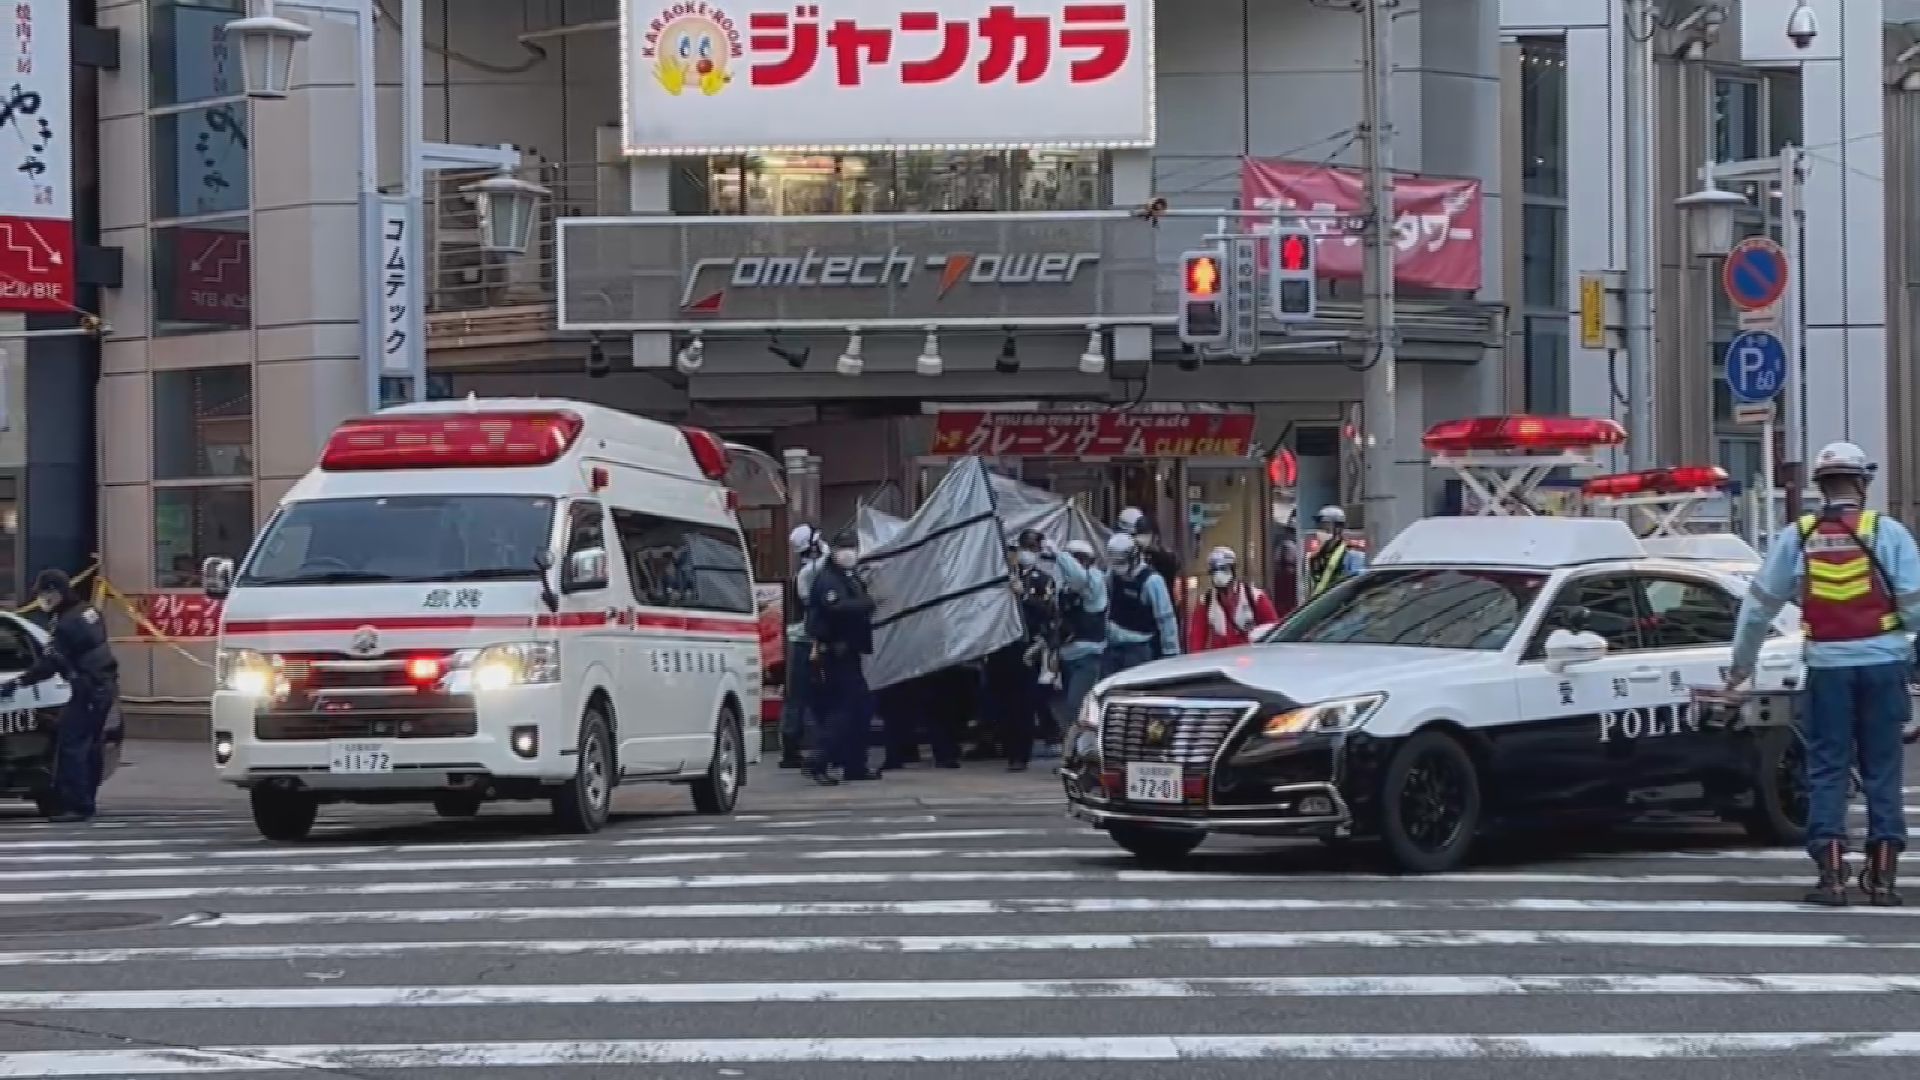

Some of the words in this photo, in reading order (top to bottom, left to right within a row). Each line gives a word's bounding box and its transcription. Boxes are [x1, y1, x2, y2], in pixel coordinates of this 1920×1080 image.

[750, 4, 1132, 87] ジャンカラ
[385, 219, 407, 356] コムテック
[1739, 347, 1765, 391] P
[965, 426, 1147, 456] クレーンゲーム
